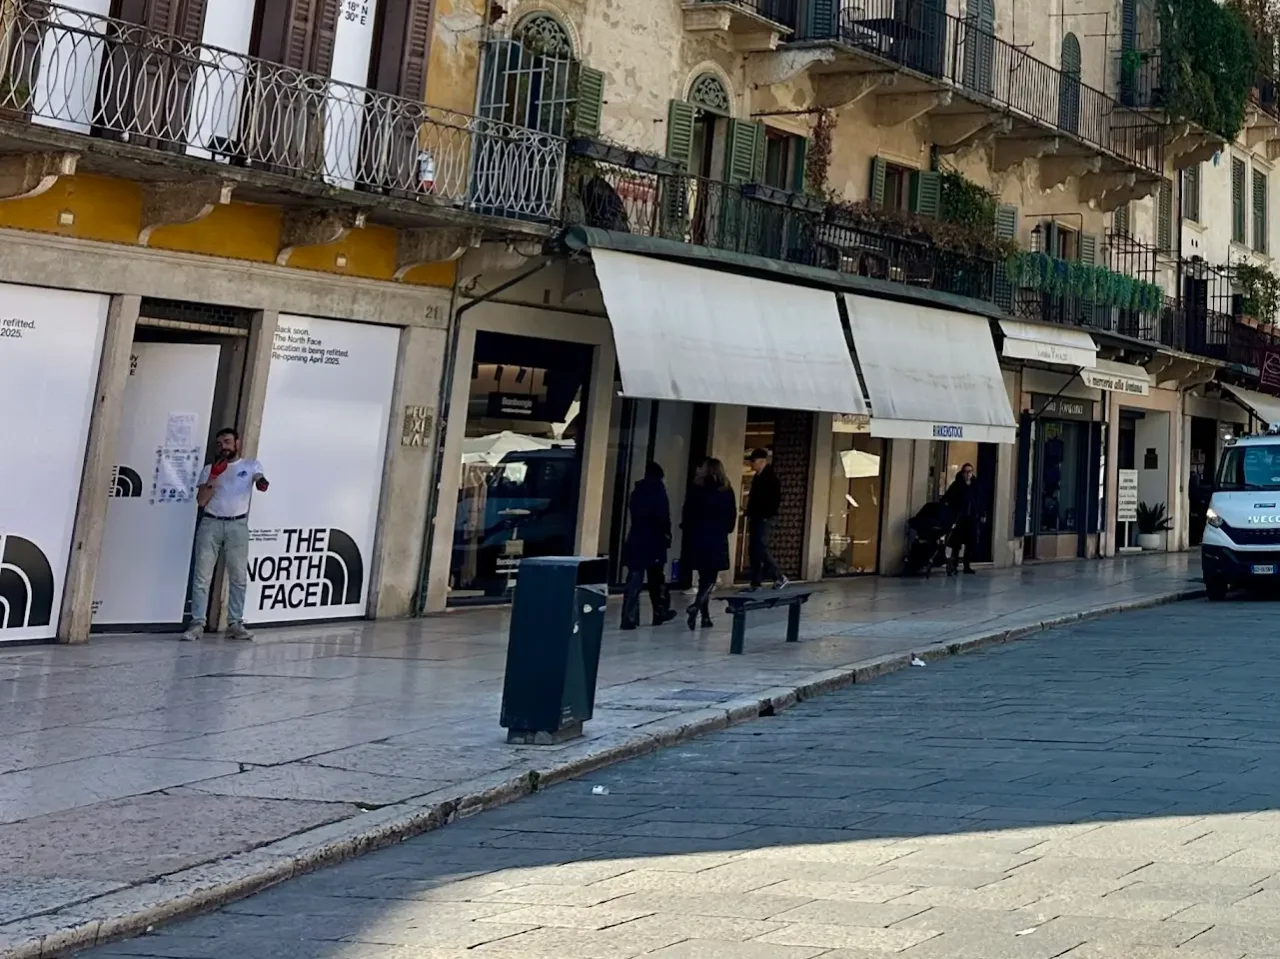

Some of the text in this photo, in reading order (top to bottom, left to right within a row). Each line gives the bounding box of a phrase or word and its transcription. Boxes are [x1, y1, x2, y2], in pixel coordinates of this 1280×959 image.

[361, 5, 369, 16] N
[360, 15, 367, 26] E
[0, 327, 23, 339] 2025.
[293, 327, 310, 336] soon.
[274, 333, 322, 346] The North Face
[272, 343, 301, 352] Location
[308, 347, 326, 356] being
[326, 348, 349, 357] refitted.
[272, 351, 341, 366] Re-opening April 2025.
[283, 528, 327, 553] THE
[247, 554, 324, 583] NORTH
[259, 582, 320, 611] FACE
